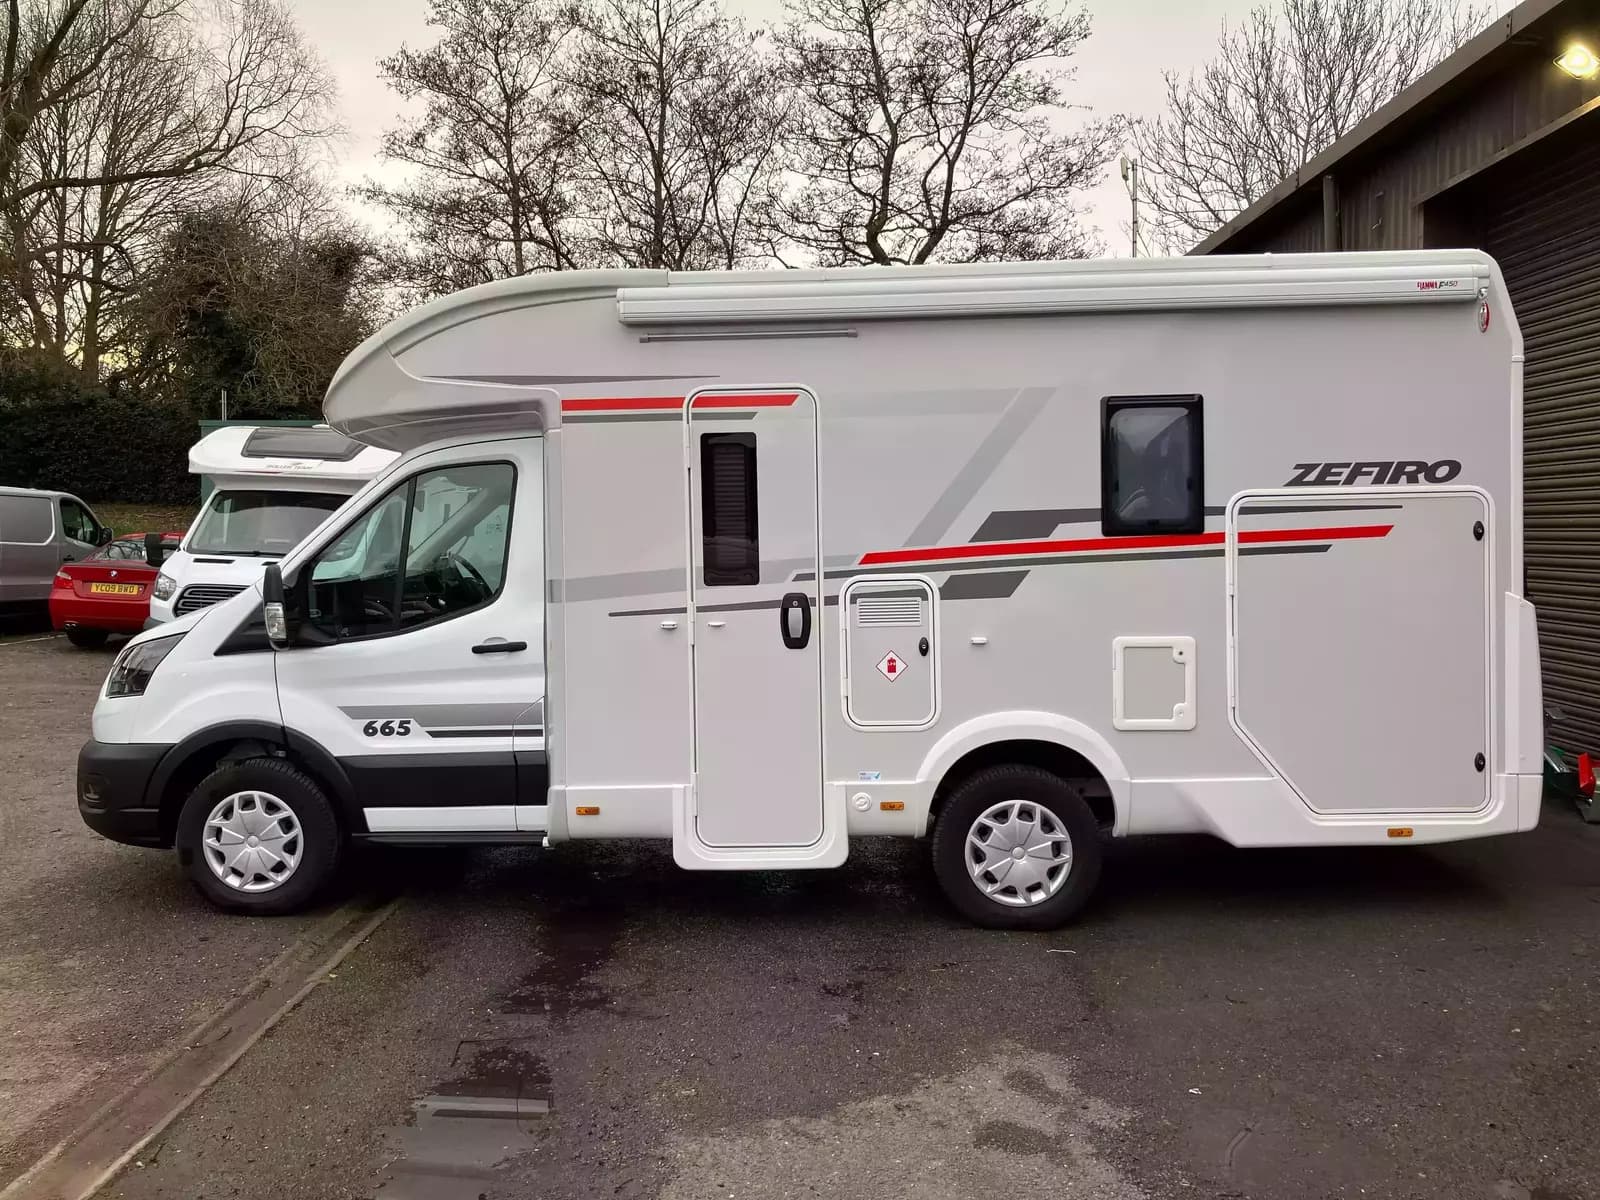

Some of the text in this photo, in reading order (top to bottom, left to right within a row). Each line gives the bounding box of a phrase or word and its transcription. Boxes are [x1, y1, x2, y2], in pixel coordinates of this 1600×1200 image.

[1283, 459, 1462, 487] ZEFIRO
[95, 583, 116, 592] YC09
[363, 719, 411, 737] 665
